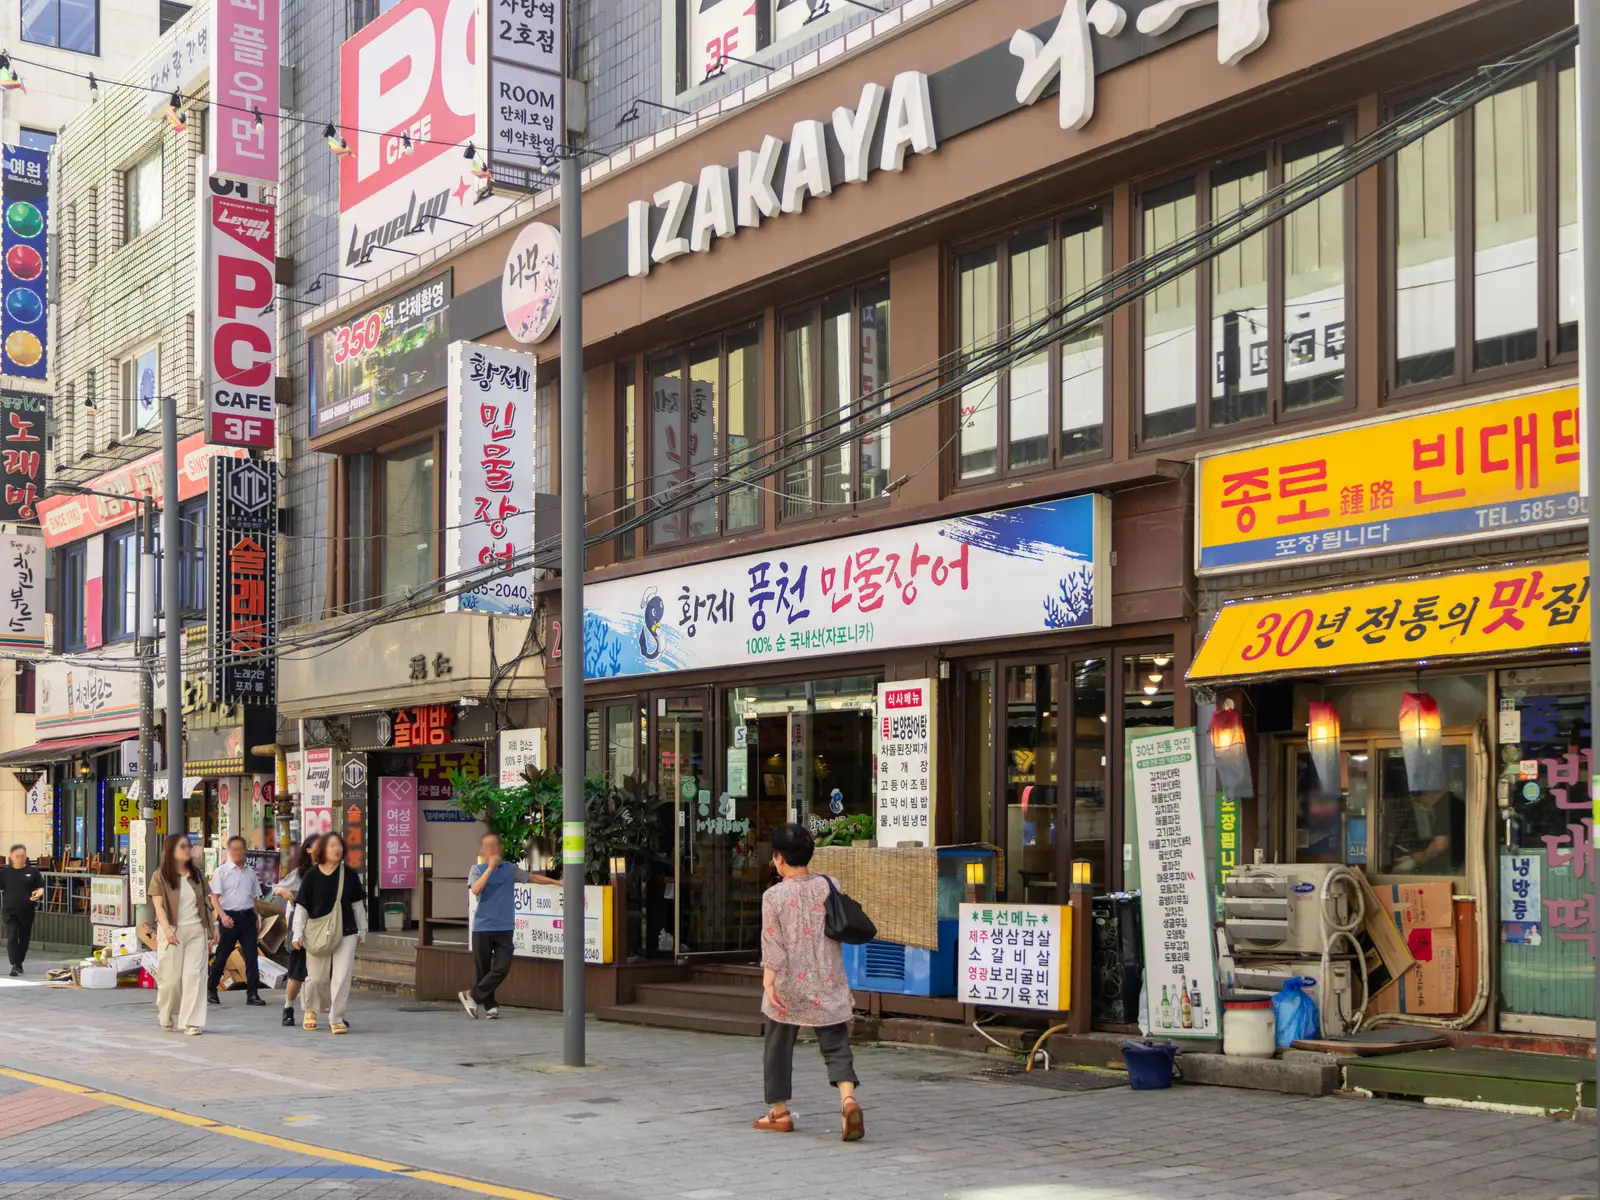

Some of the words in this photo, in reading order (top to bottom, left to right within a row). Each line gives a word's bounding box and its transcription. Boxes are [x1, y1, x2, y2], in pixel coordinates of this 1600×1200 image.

[500, 20, 554, 53] 2호점
[705, 27, 739, 74] 3F
[499, 82, 554, 109] ROOM
[500, 105, 554, 131] 단체모임
[386, 114, 432, 165] CAFE
[500, 129, 555, 153] 예약환영
[10, 158, 41, 178] 예원
[628, 71, 937, 277] IZAKAYA
[508, 242, 540, 292] 나무
[213, 255, 275, 388] PC
[469, 352, 530, 392] 황제
[215, 390, 271, 412] CAFE
[224, 417, 262, 441] 3F
[3, 410, 41, 520] 노래방
[232, 470, 269, 505] JMC
[1221, 458, 1331, 534] 종로
[1339, 480, 1395, 517] 鍾路
[49, 514, 67, 530] SINCE
[1274, 524, 1391, 557] 포장됩니다
[229, 537, 267, 657] 술래방
[678, 585, 735, 638] 황제
[748, 561, 811, 632] 풍천
[821, 541, 970, 613] 민물장어
[1241, 606, 1350, 662] 30년
[1355, 596, 1481, 646] 전통의
[1481, 570, 1591, 635] 맛집
[746, 636, 772, 655] 100%
[776, 636, 787, 653] 순
[790, 621, 875, 651] 국내산(자포니카)
[887, 691, 920, 707] 식사메뉴
[394, 704, 447, 748] 술래방
[1136, 744, 1154, 757] 30년
[1156, 739, 1172, 754] 전통
[1174, 737, 1191, 751] 맛집
[880, 778, 928, 791] 고등어조림
[387, 809, 411, 822] 여성
[387, 823, 411, 837] 전문
[387, 840, 411, 854] 헬스
[391, 873, 406, 885] 4F
[968, 947, 1051, 967] 소갈비살
[968, 984, 1049, 1007] 소고기육전
